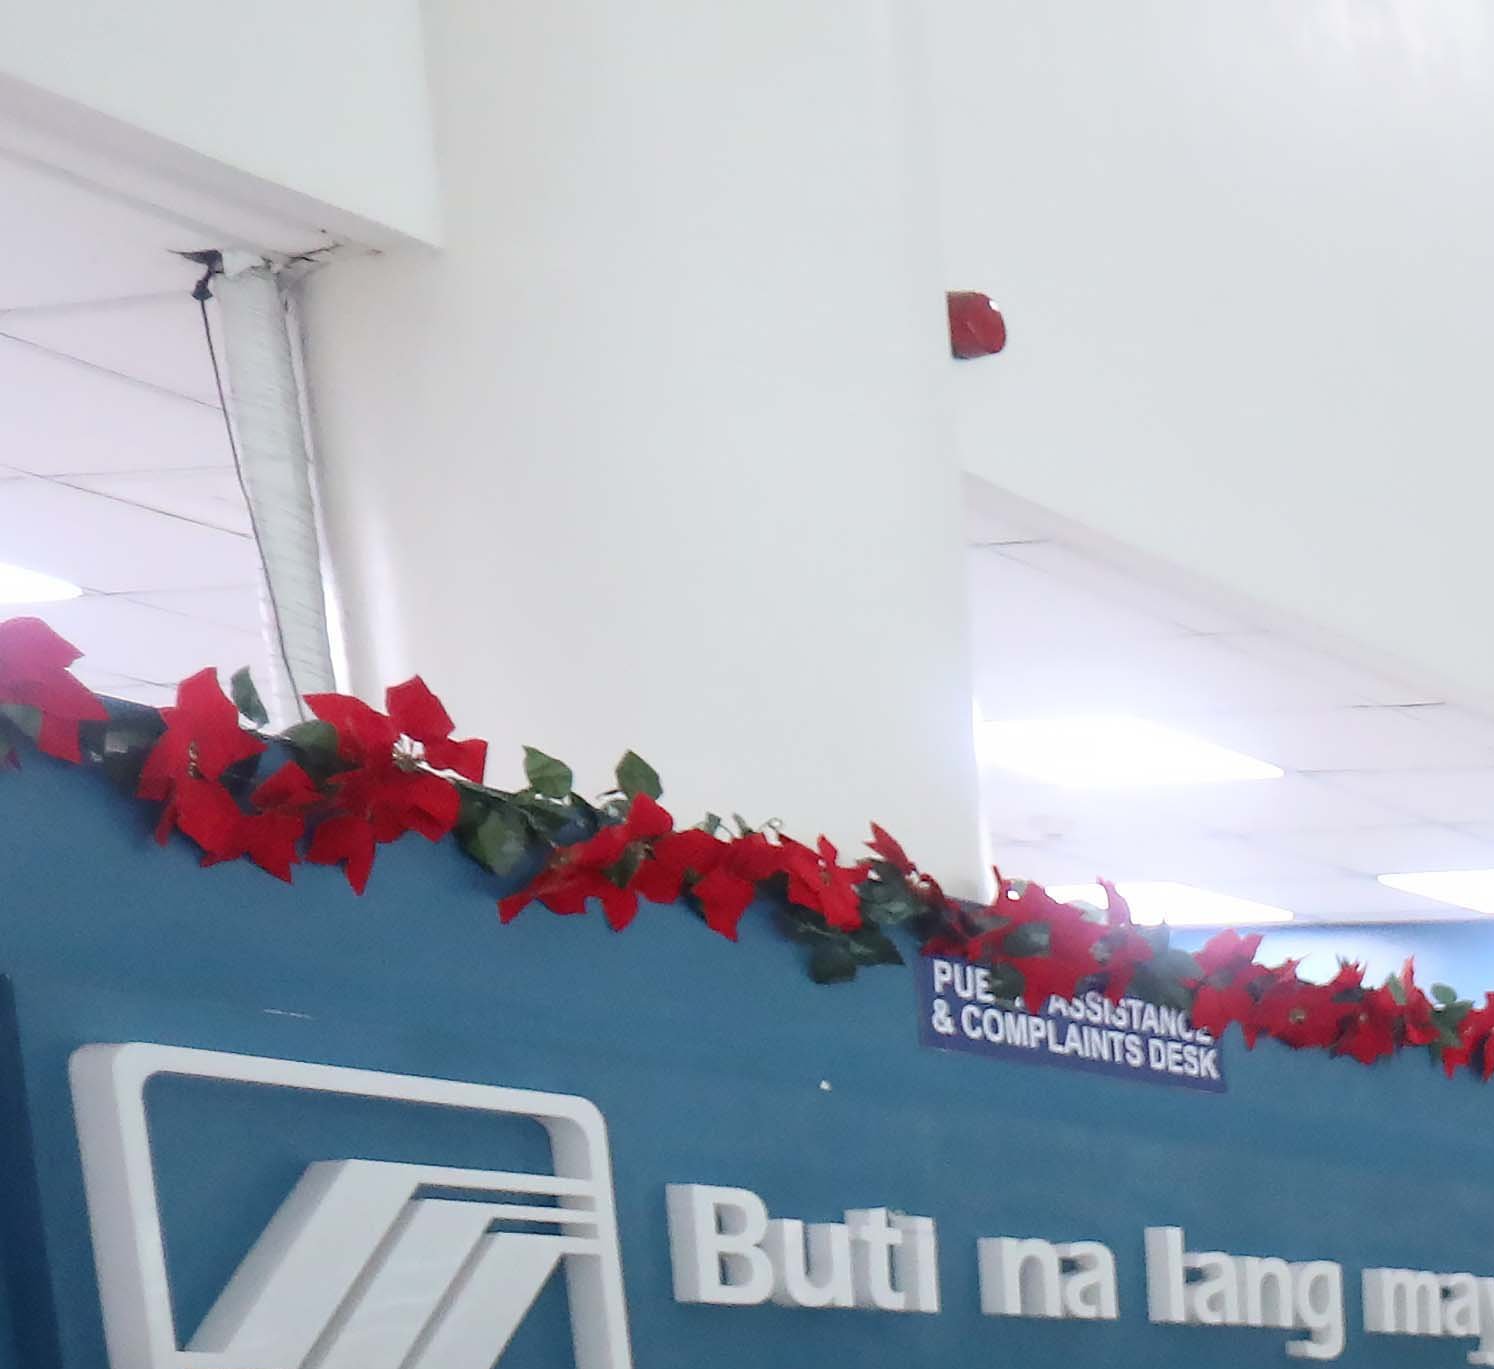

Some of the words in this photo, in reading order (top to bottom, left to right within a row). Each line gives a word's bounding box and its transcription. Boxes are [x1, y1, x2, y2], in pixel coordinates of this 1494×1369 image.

[931, 998, 956, 1035] &
[960, 1004, 1146, 1068] COMPLAINTS
[1149, 1037, 1221, 1081] DESK
[665, 1181, 940, 1315] Buti
[977, 1234, 1120, 1321] na
[1143, 1224, 1347, 1361] lang
